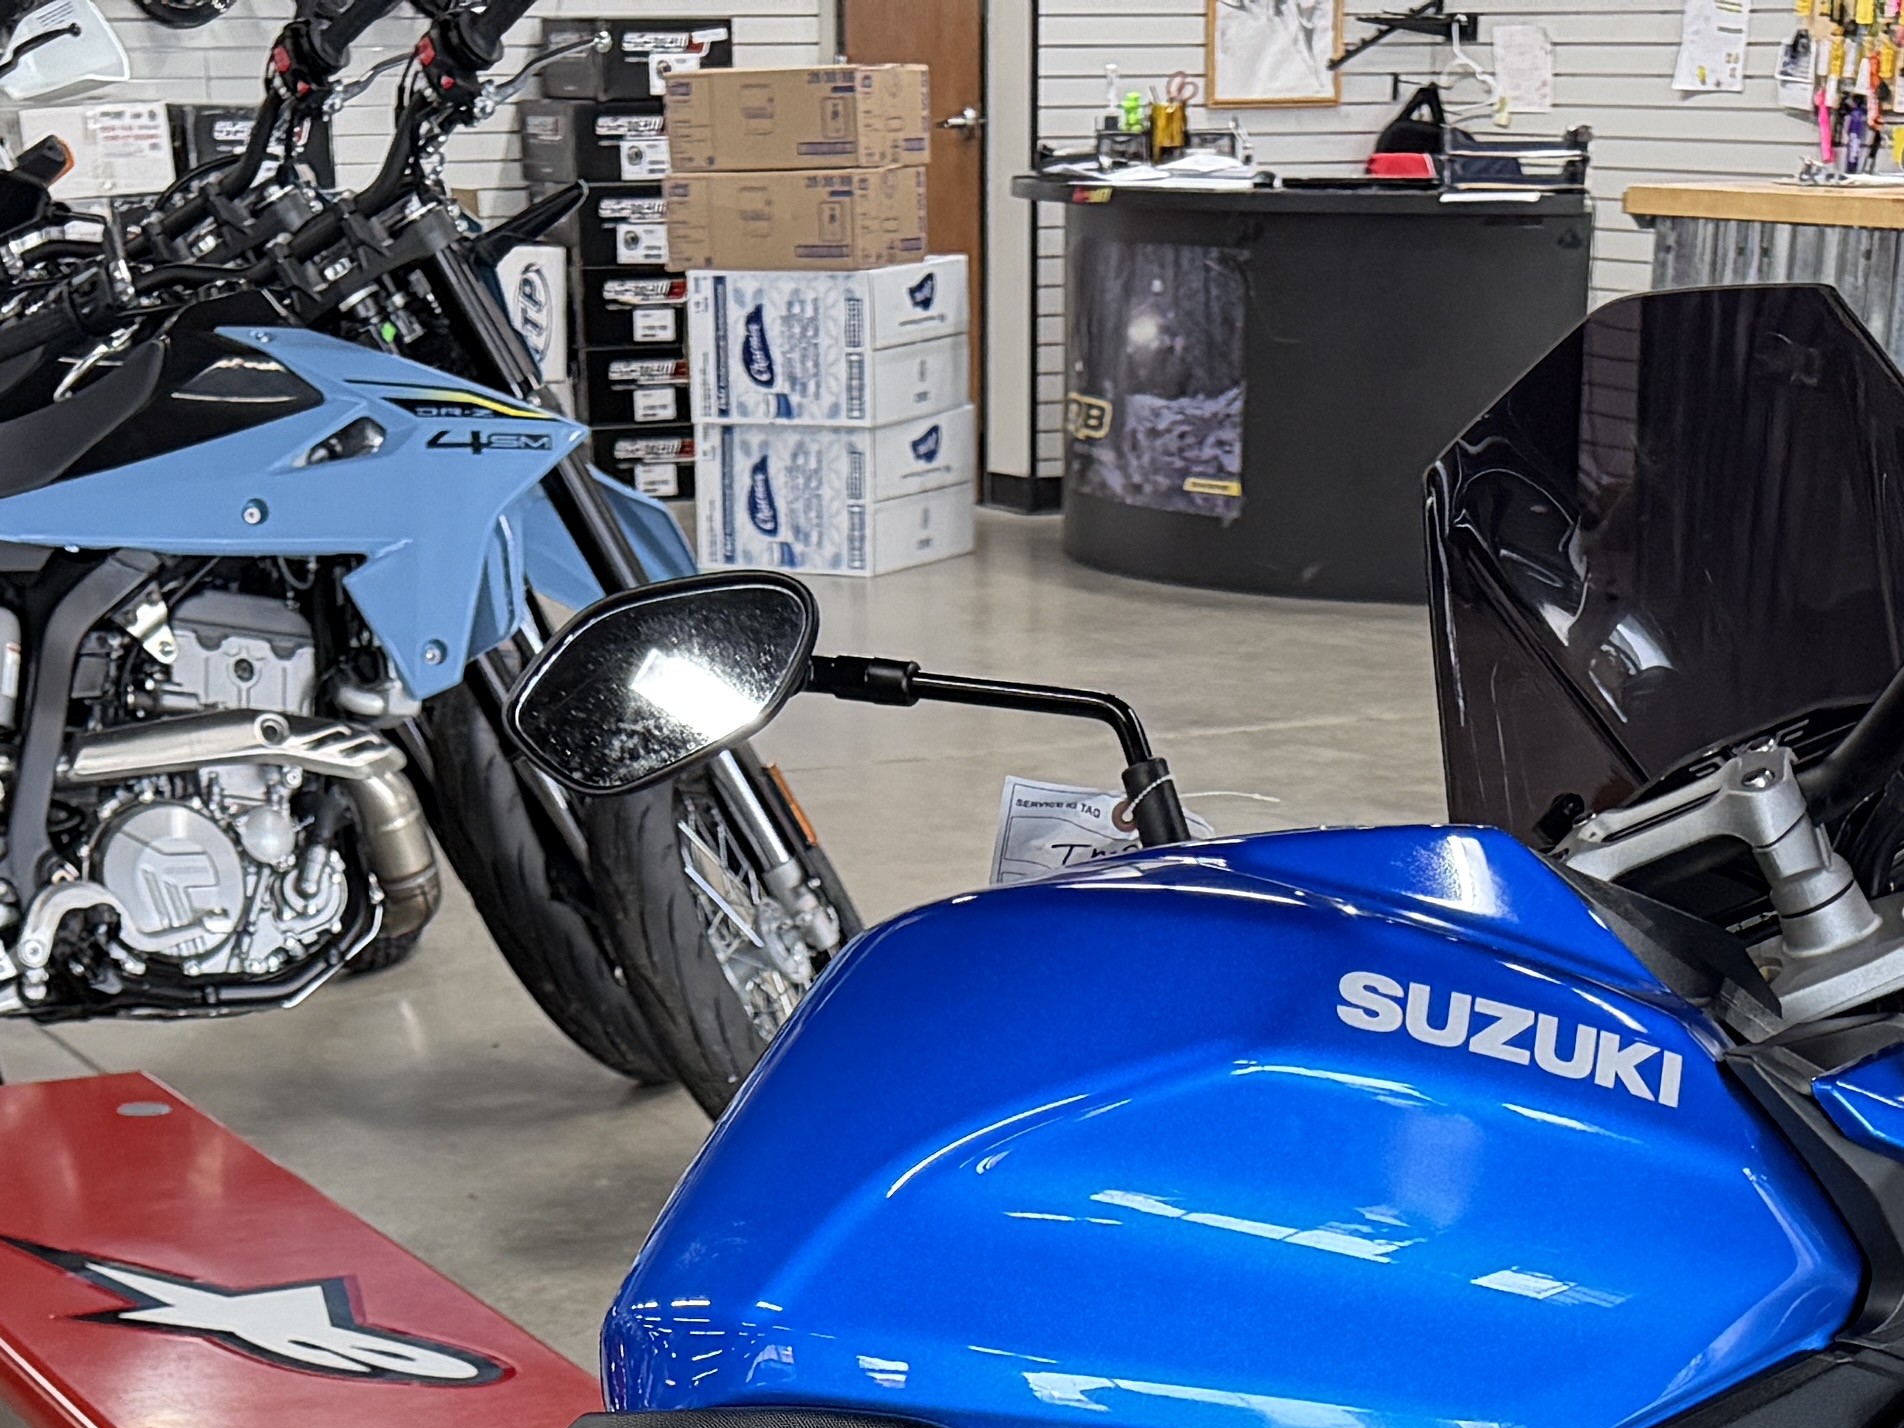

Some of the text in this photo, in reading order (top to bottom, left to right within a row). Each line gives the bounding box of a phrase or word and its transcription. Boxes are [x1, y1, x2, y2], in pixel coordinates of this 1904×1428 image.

[414, 406, 496, 418] DR-Z
[426, 430, 553, 455] 4SM
[1336, 970, 1684, 1108] SUZUKI
